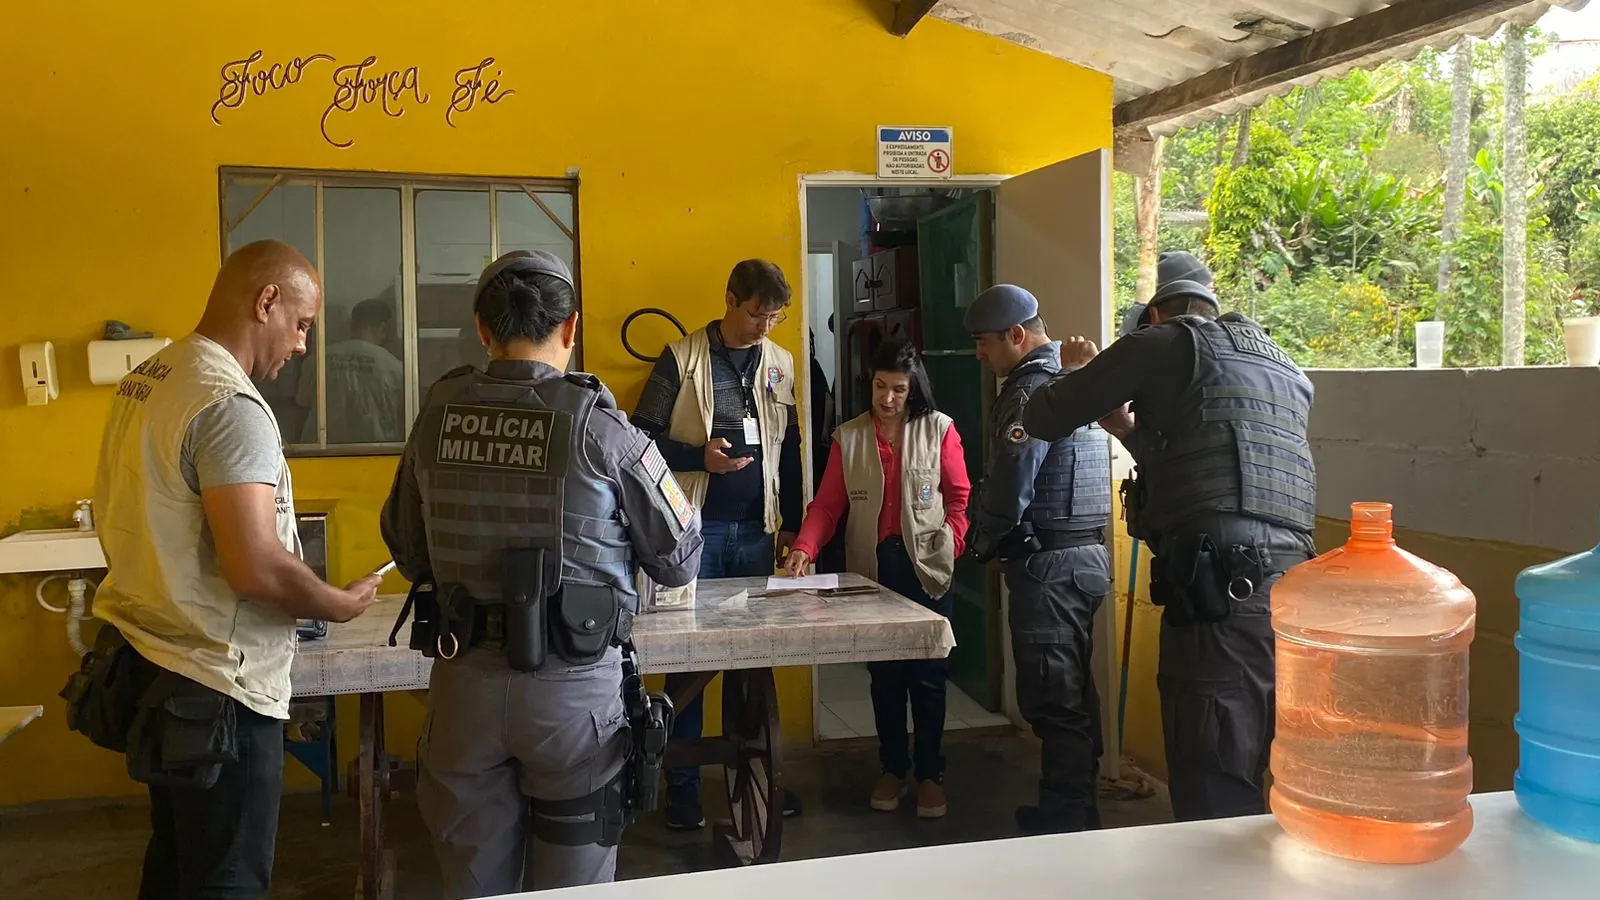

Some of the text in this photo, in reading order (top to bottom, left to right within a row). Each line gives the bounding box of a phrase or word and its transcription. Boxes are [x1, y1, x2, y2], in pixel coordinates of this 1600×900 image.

[211, 49, 517, 150] Foco Força Fé
[898, 130, 931, 141] AVISO
[444, 412, 545, 440] POLÍCIA
[441, 438, 543, 467] MILITAR
